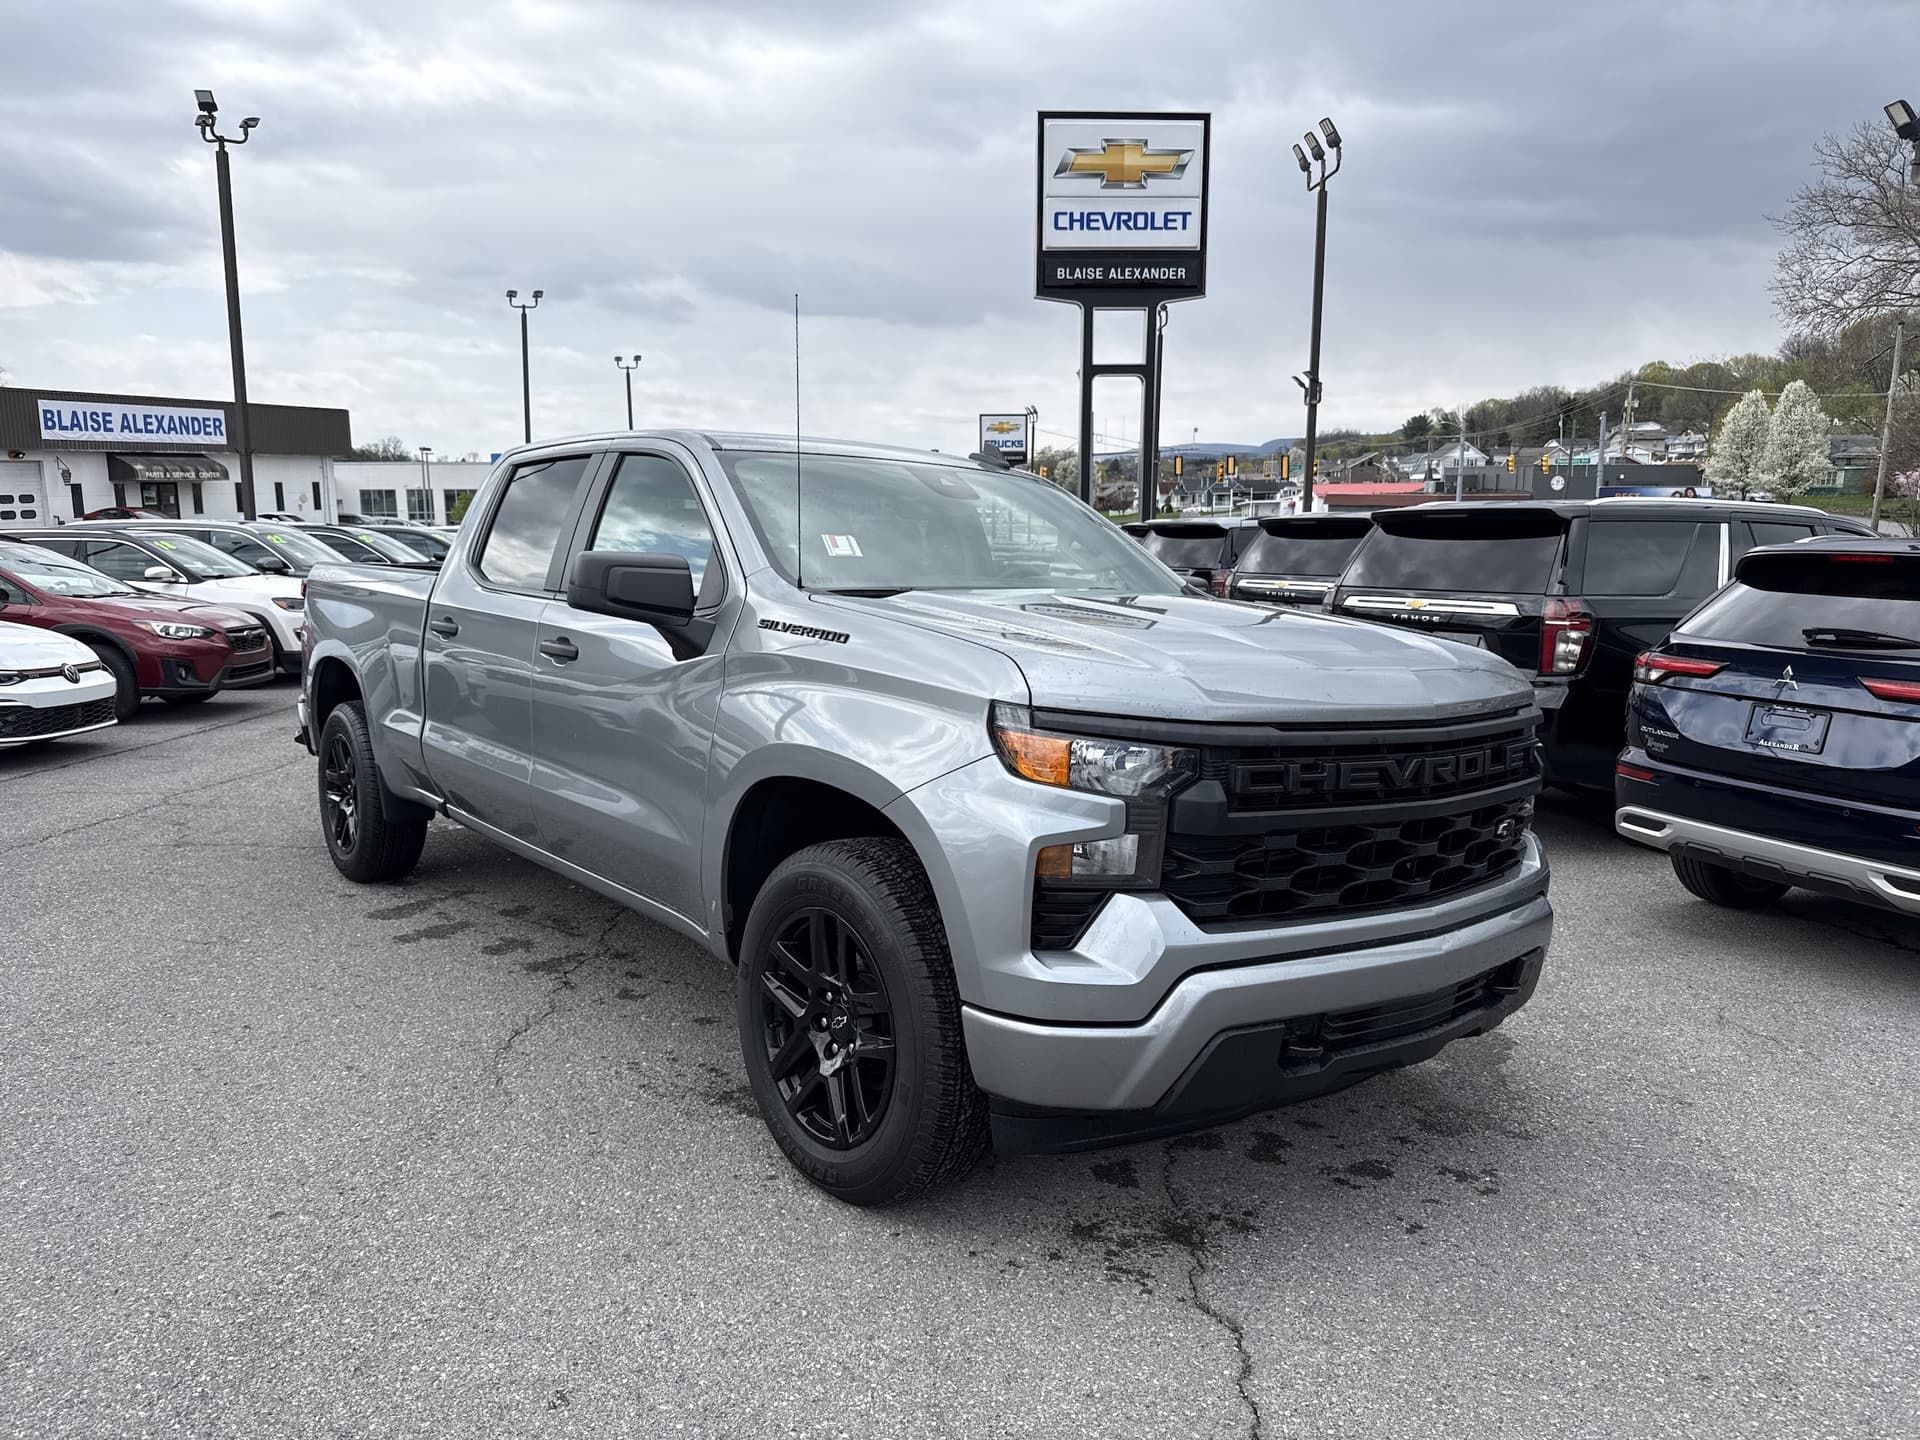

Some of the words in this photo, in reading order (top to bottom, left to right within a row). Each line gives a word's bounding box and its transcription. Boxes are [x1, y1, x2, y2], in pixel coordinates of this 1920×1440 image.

[1053, 211, 1192, 231] CHEVROLET
[1057, 267, 1104, 280] BLAISE
[1109, 267, 1186, 280] ALEXANDER
[42, 409, 114, 433] BLAISE
[120, 413, 224, 437] ALEXANDER
[145, 471, 164, 479] PARTS
[172, 471, 196, 479] SERVICE
[198, 471, 220, 479] CENTER
[1391, 613, 1441, 623] TAHOE
[757, 618, 850, 645] SILVERADO
[1640, 725, 1679, 740] OUTLANDER
